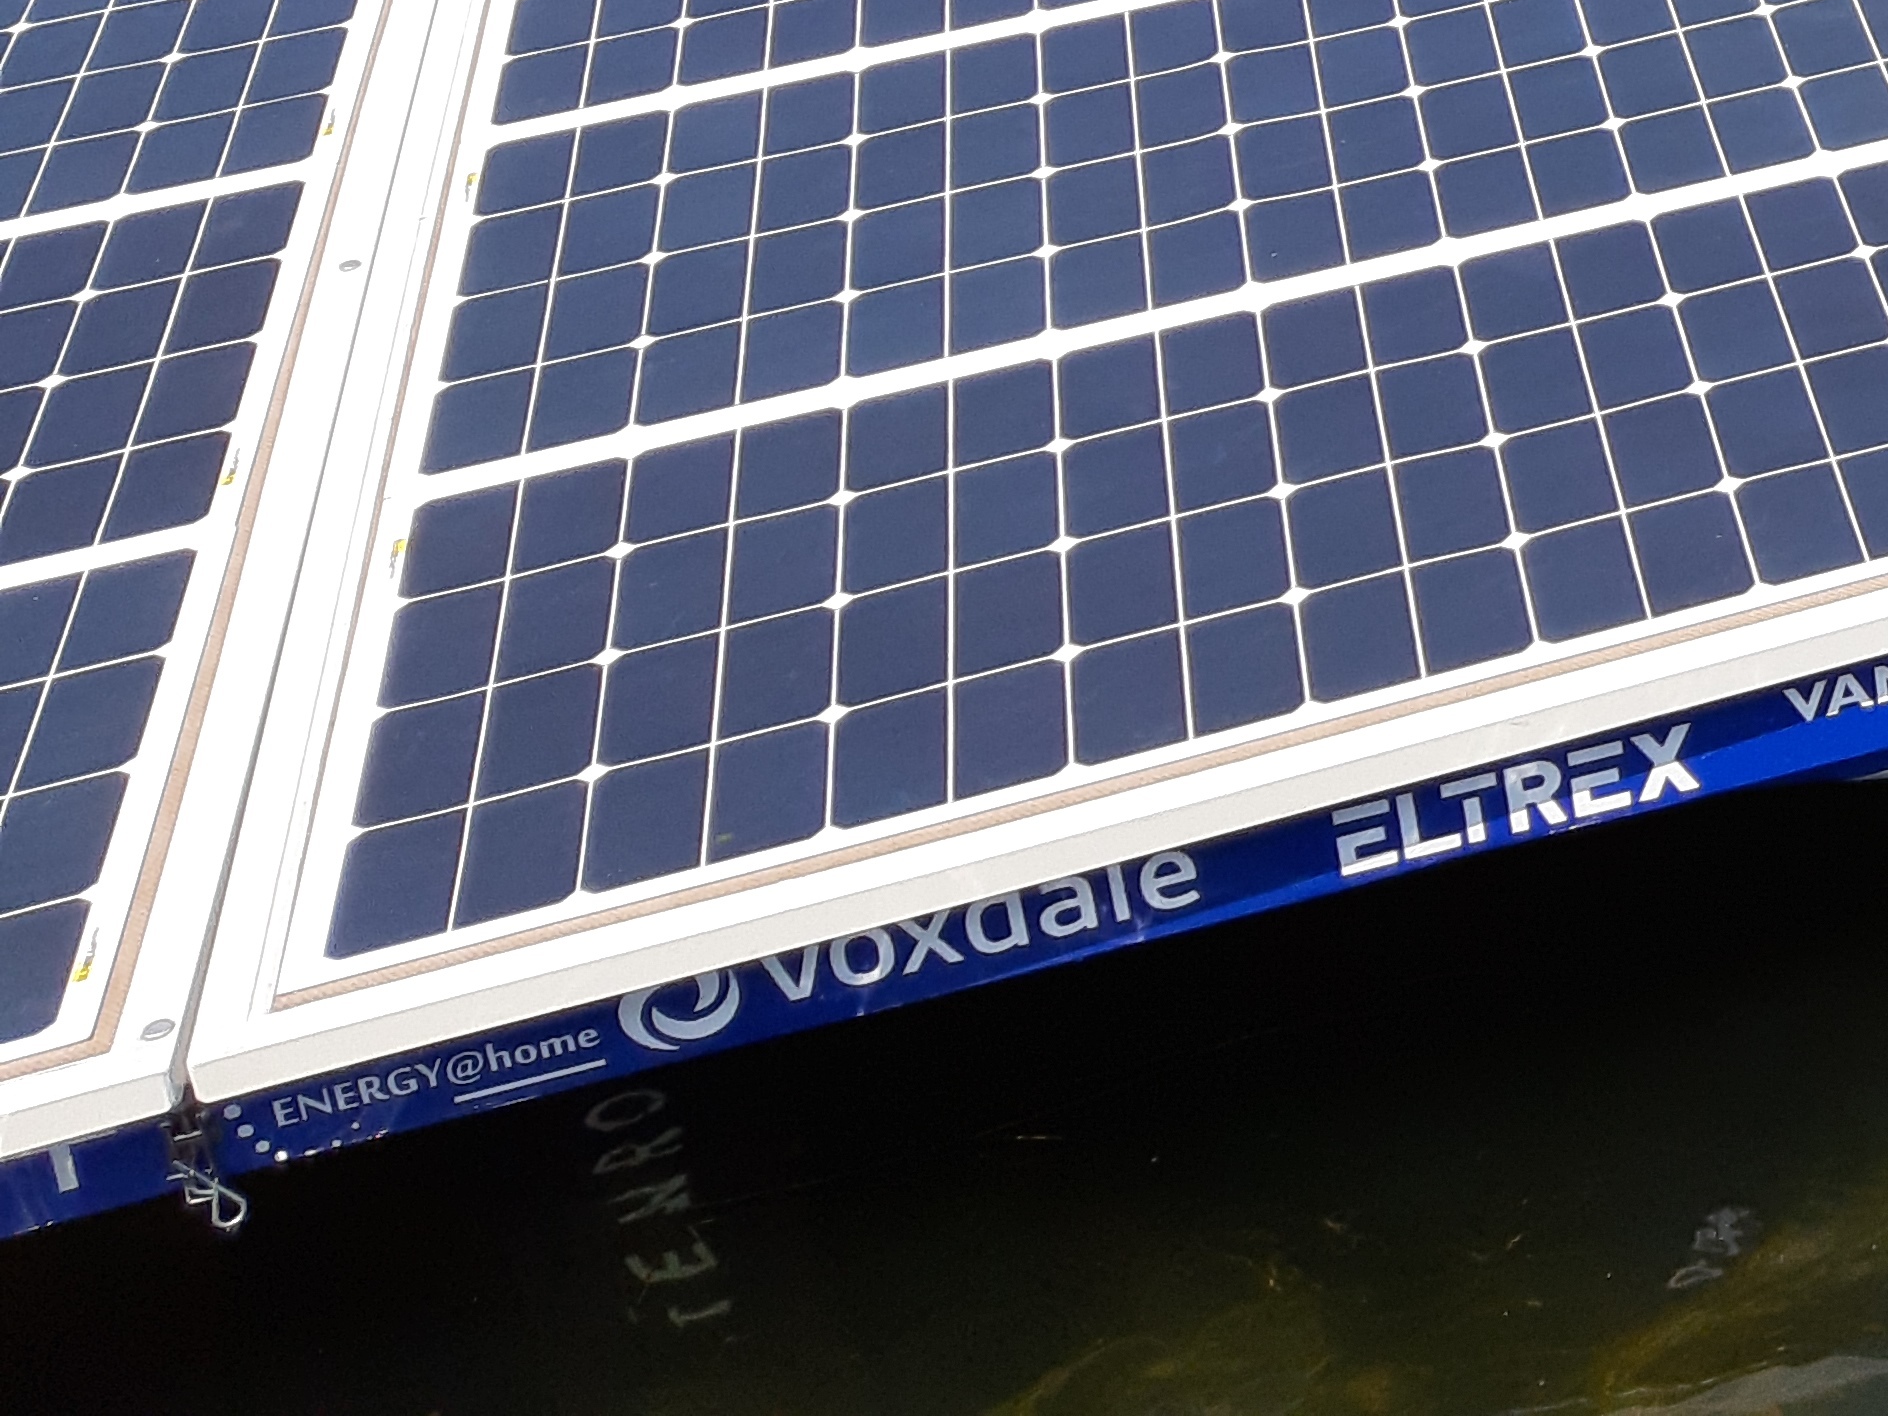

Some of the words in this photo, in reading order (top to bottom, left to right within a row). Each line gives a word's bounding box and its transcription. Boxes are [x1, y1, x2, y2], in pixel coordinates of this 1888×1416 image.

[1331, 722, 1702, 878] ELTREX
[756, 849, 1201, 1003] voxdale
[271, 1025, 601, 1128] ENERGY@home
